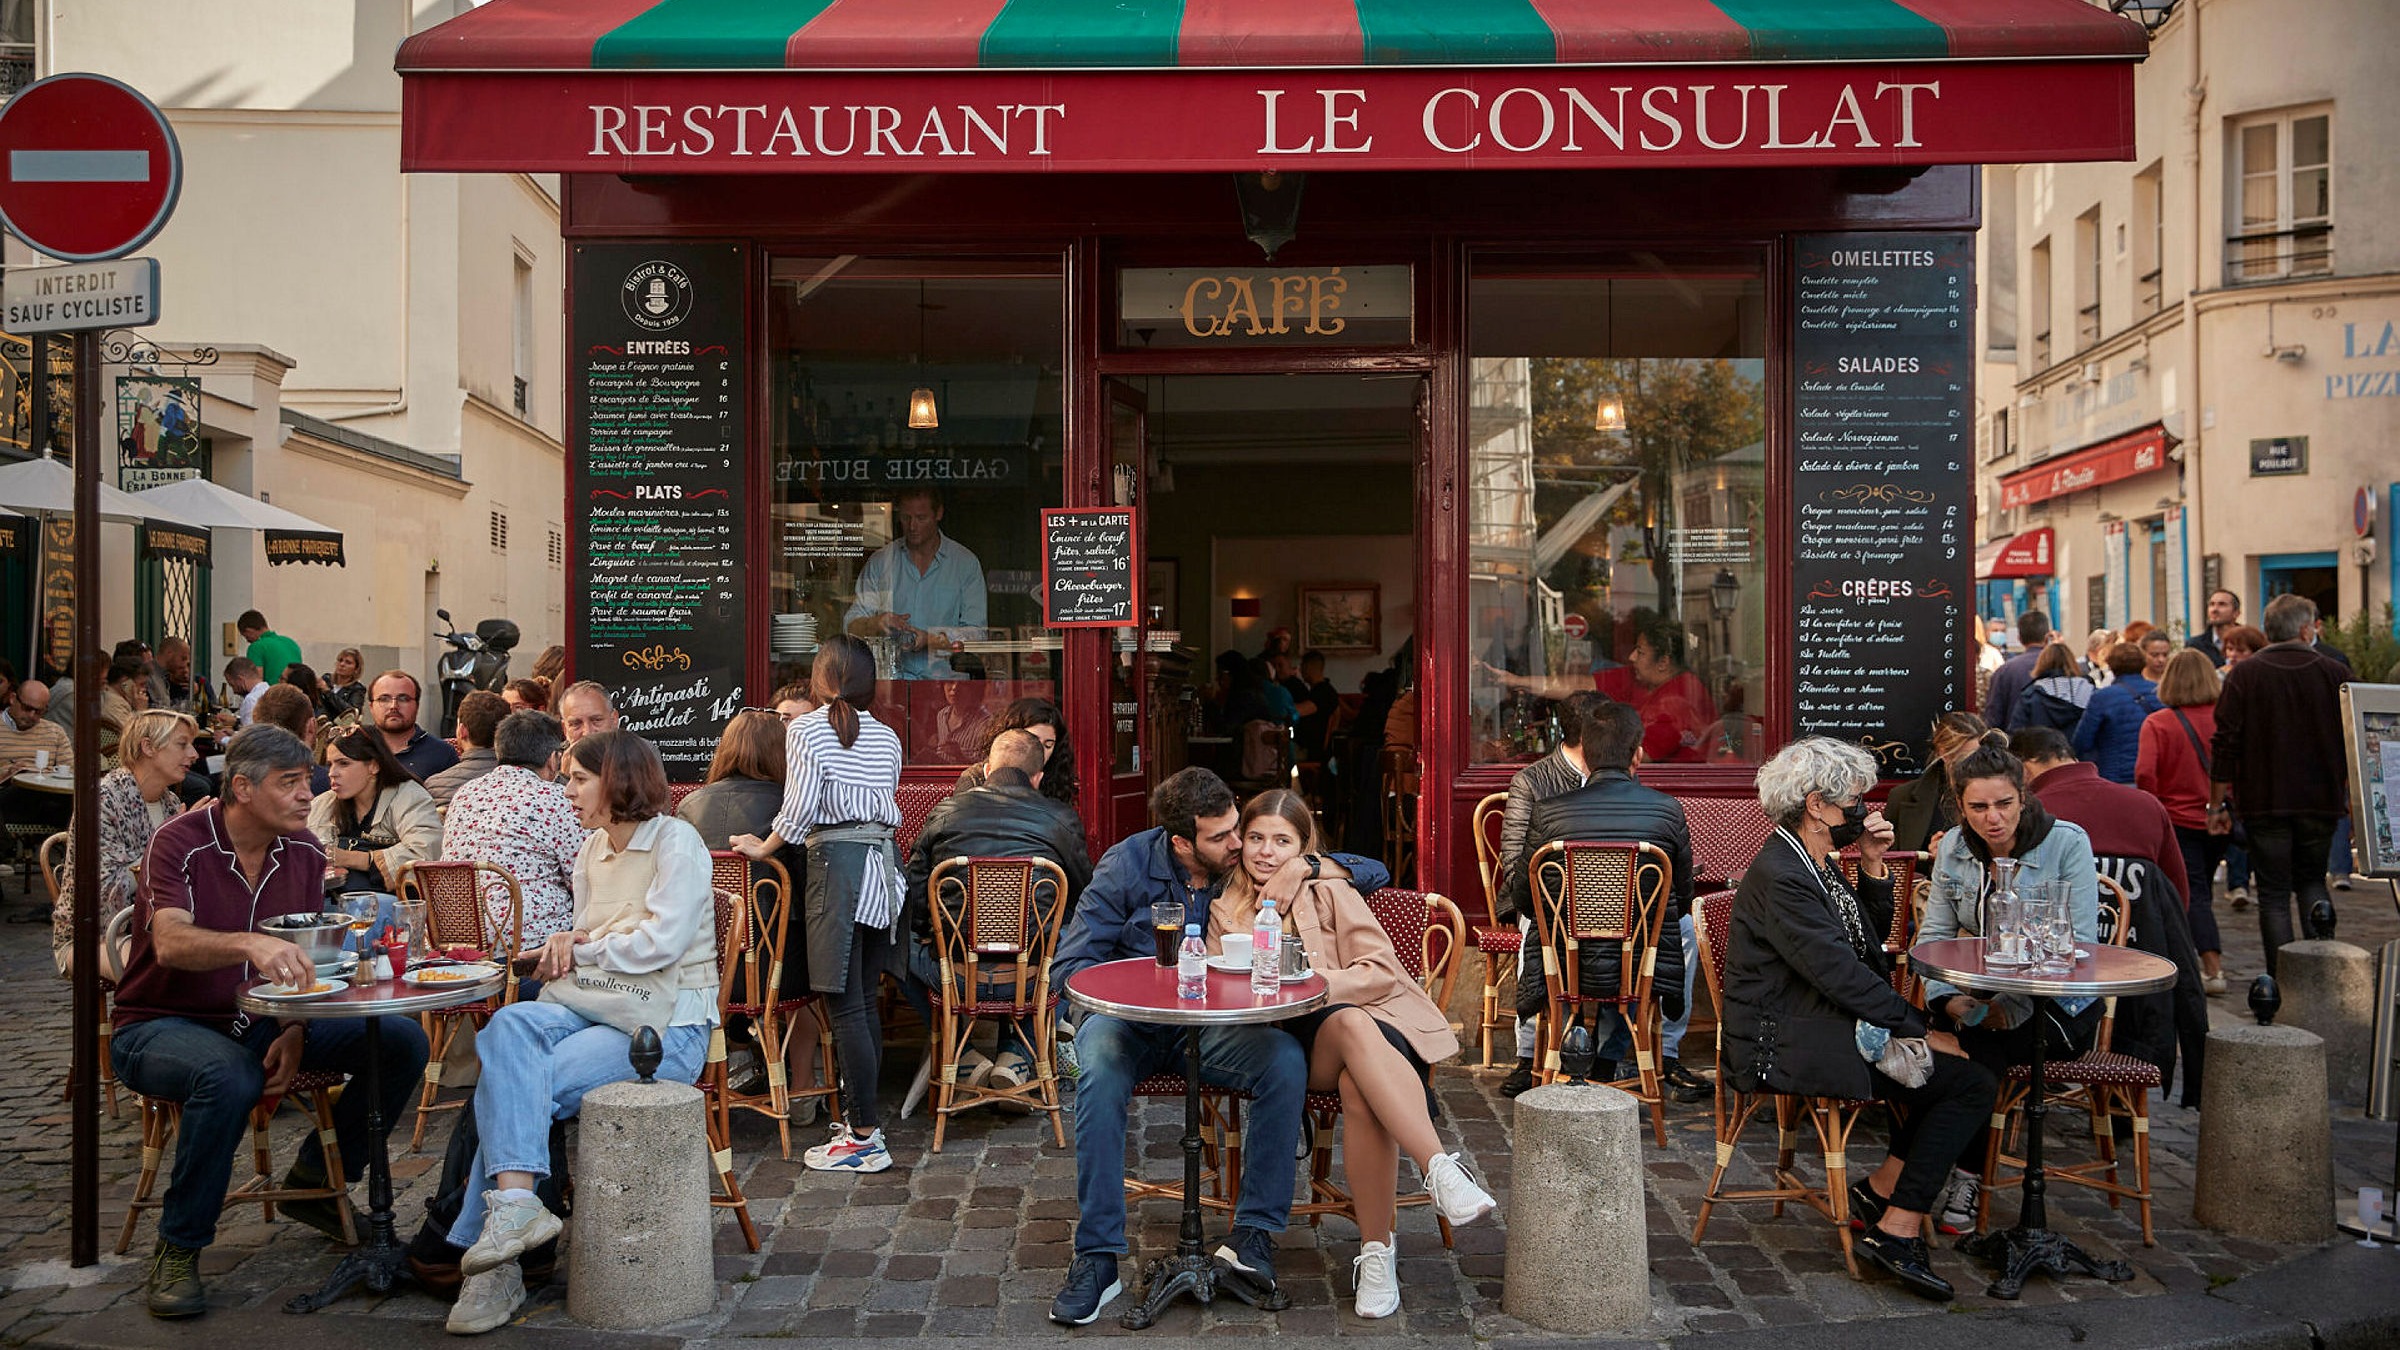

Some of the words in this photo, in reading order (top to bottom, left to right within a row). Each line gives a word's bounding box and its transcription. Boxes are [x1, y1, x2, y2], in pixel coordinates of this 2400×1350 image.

[1257, 90, 1373, 154] LE
[1422, 81, 1940, 153] CONSULAT
[588, 103, 1065, 156] RESTAURANT
[1832, 251, 1934, 266] OMELETTES
[36, 272, 117, 296] INTERDIT
[625, 264, 656, 292] Bistrot
[658, 265, 666, 274] &
[667, 267, 688, 289] Café
[1801, 276, 1839, 285] Omelette
[1801, 290, 1839, 300] Omelette
[1180, 267, 1347, 336] CAFÉ
[10, 303, 54, 323] SAUF
[62, 295, 144, 319] CYCLISTE
[1801, 305, 1838, 314] Omelette
[634, 313, 660, 327] Depuis
[1801, 320, 1839, 329] Omelette
[2344, 320, 2400, 359] LA
[627, 340, 690, 355] ENTRÉES
[588, 361, 617, 373] Soupe
[1838, 357, 1920, 373] SALADES
[596, 379, 633, 389] escargots
[636, 378, 646, 387] de
[650, 377, 700, 389] Bourgogne
[1801, 381, 1831, 391] Salade
[2326, 372, 2400, 400] PIZZ
[600, 396, 636, 405] escargots
[639, 395, 649, 404] de
[652, 394, 700, 405] Bourgogne
[1800, 408, 1831, 418] Salade
[621, 428, 631, 436] de
[1800, 432, 1834, 442] Salade
[622, 444, 633, 452] de
[719, 444, 729, 452] 21
[723, 459, 730, 468] 9
[1800, 460, 1831, 471] Salade
[1833, 461, 1843, 471] de
[133, 471, 145, 480] LA
[152, 471, 185, 481] BONNE
[635, 485, 682, 500] PLATS
[590, 506, 625, 517] Moules
[1801, 504, 1832, 520] Croque
[1048, 516, 1065, 527] LES
[1069, 516, 1078, 527] +
[1099, 515, 1129, 526] CARTE
[622, 524, 633, 533] de
[1801, 520, 1832, 535] Croque
[1084, 531, 1096, 542] de
[1801, 534, 1832, 547] Croque
[589, 540, 612, 550] Pavé
[614, 541, 626, 550] de
[1841, 549, 1852, 559] de
[1946, 547, 1956, 560] 9
[590, 557, 636, 569] Linguine
[590, 573, 628, 585] Magret
[631, 573, 643, 583] de
[647, 573, 681, 583] canard
[1842, 578, 1912, 596] CRÊPES
[590, 590, 618, 602] Confit
[621, 590, 633, 600] de
[636, 589, 673, 600] canard
[590, 606, 613, 616] Pavé
[616, 606, 628, 616] de
[631, 607, 667, 616] saumon
[1813, 618, 1823, 628] la
[1865, 619, 1875, 628] de
[1945, 618, 1953, 628] 6
[1811, 633, 1823, 642] la
[1944, 633, 1953, 643] 6
[1944, 649, 1953, 659] 6
[1812, 664, 1822, 676] la
[1854, 666, 1866, 676] de
[1944, 666, 1953, 676] 6
[1944, 683, 1953, 694] 8
[1944, 701, 1953, 711] 6
[660, 737, 698, 747] mozzarella
[592, 977, 651, 1002] collecting
